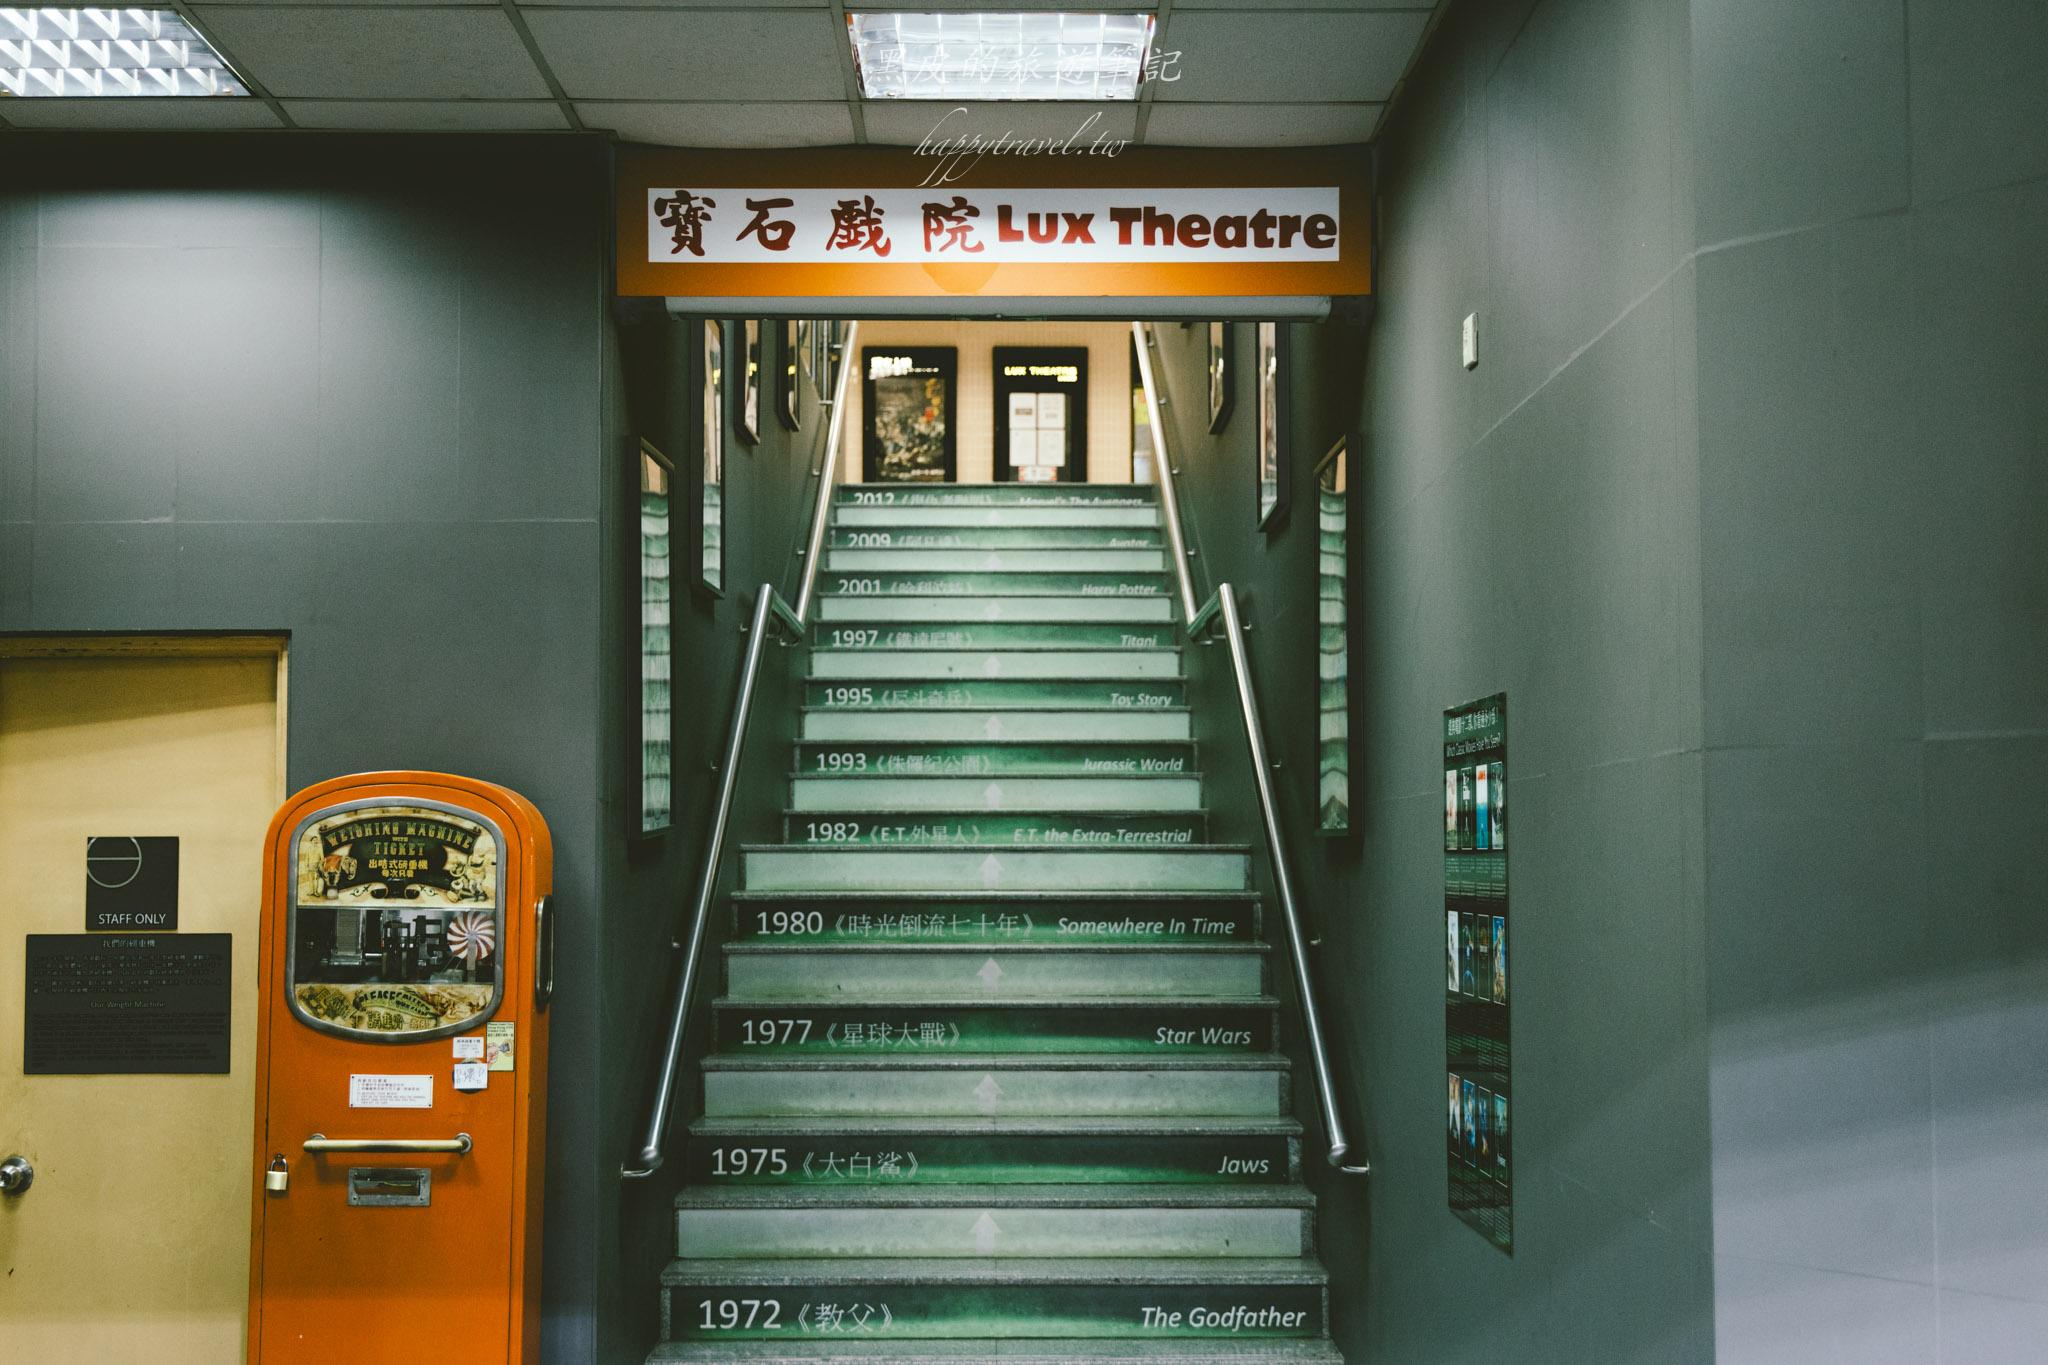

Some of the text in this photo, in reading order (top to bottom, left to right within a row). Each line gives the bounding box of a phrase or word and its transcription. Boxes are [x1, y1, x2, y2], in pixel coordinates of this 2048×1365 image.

[653, 189, 1340, 258] 寶石戲院 Lux Theatre
[848, 532, 891, 547] 2009
[838, 578, 881, 594] 2001
[1118, 583, 1158, 594] Potter
[831, 629, 879, 648] 1997
[824, 687, 873, 705] 1995
[1110, 693, 1135, 707] Toy
[1137, 692, 1173, 707] Story
[815, 752, 867, 772] 1993
[1081, 757, 1137, 772] Jurassic
[1140, 756, 1184, 772] World
[326, 821, 474, 849] WEIGHING MACHINE
[806, 822, 860, 842] 1982
[1013, 829, 1041, 843] E.T.
[1044, 828, 1069, 843] the
[1072, 828, 1192, 843] Extra-Terrestrial
[373, 841, 426, 856] TICKET
[98, 912, 167, 925] STAFF ONLY
[756, 911, 1236, 938] 1980 《時光倒流七十年》 Somewhere In Time
[741, 1019, 1252, 1048] 1977 《星球大戰》 Star Wars
[711, 1148, 1270, 1180] 1975 《大白鯊》 Jaws
[697, 1299, 1307, 1334] 1972 《教父》 The Godfather
